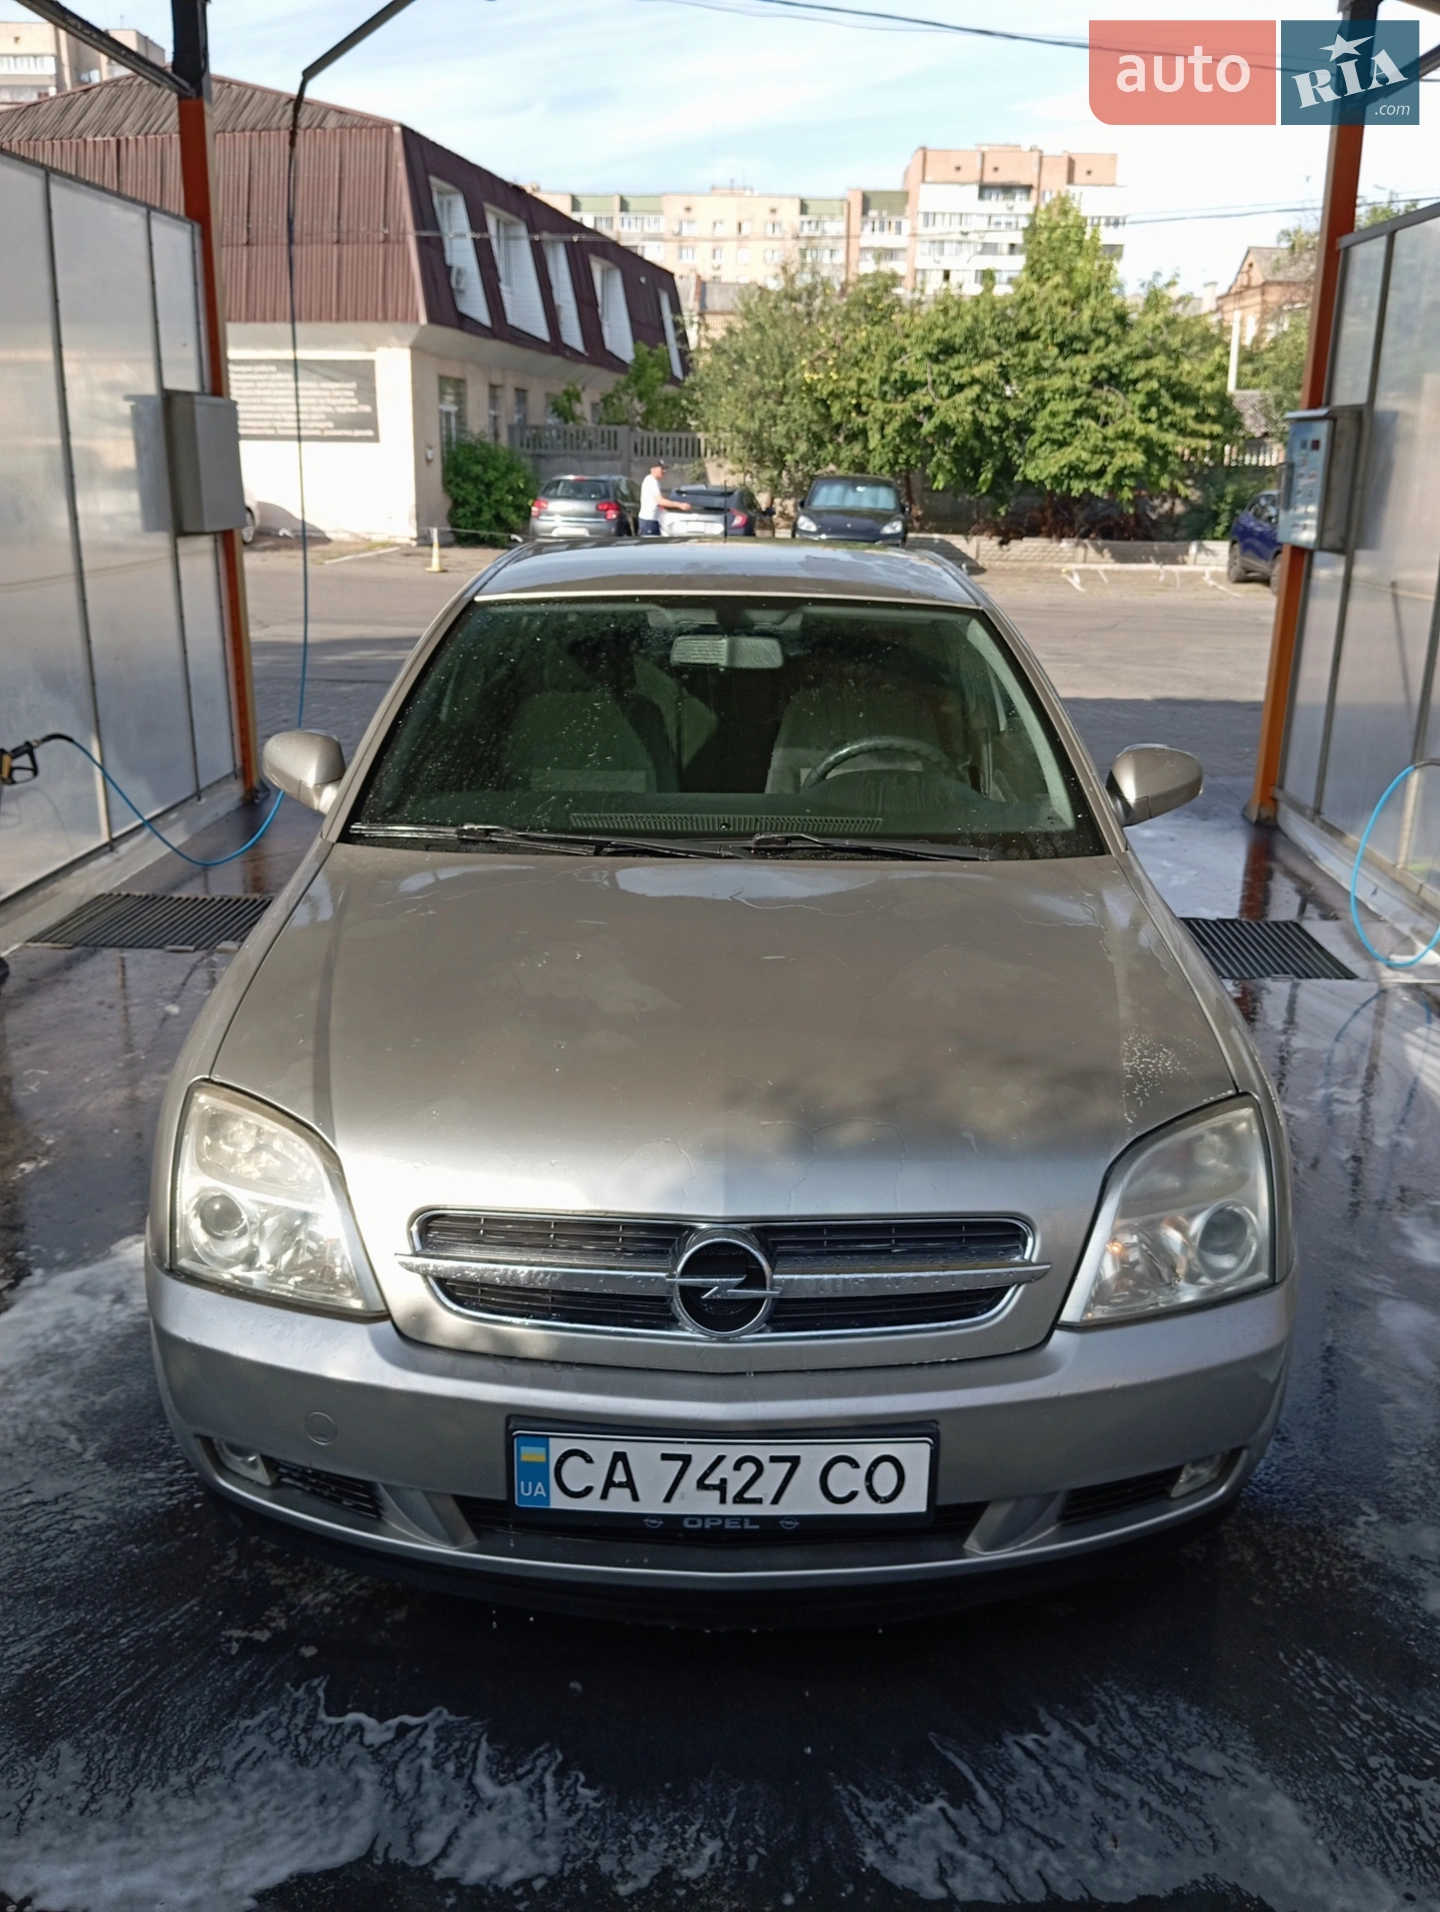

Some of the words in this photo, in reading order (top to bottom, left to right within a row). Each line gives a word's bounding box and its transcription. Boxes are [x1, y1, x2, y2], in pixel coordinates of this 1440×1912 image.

[553, 1448, 640, 1503] CA
[660, 1453, 801, 1505] 7427
[819, 1454, 906, 1505] CO
[520, 1481, 546, 1498] UA
[683, 1517, 760, 1530] OPEL
